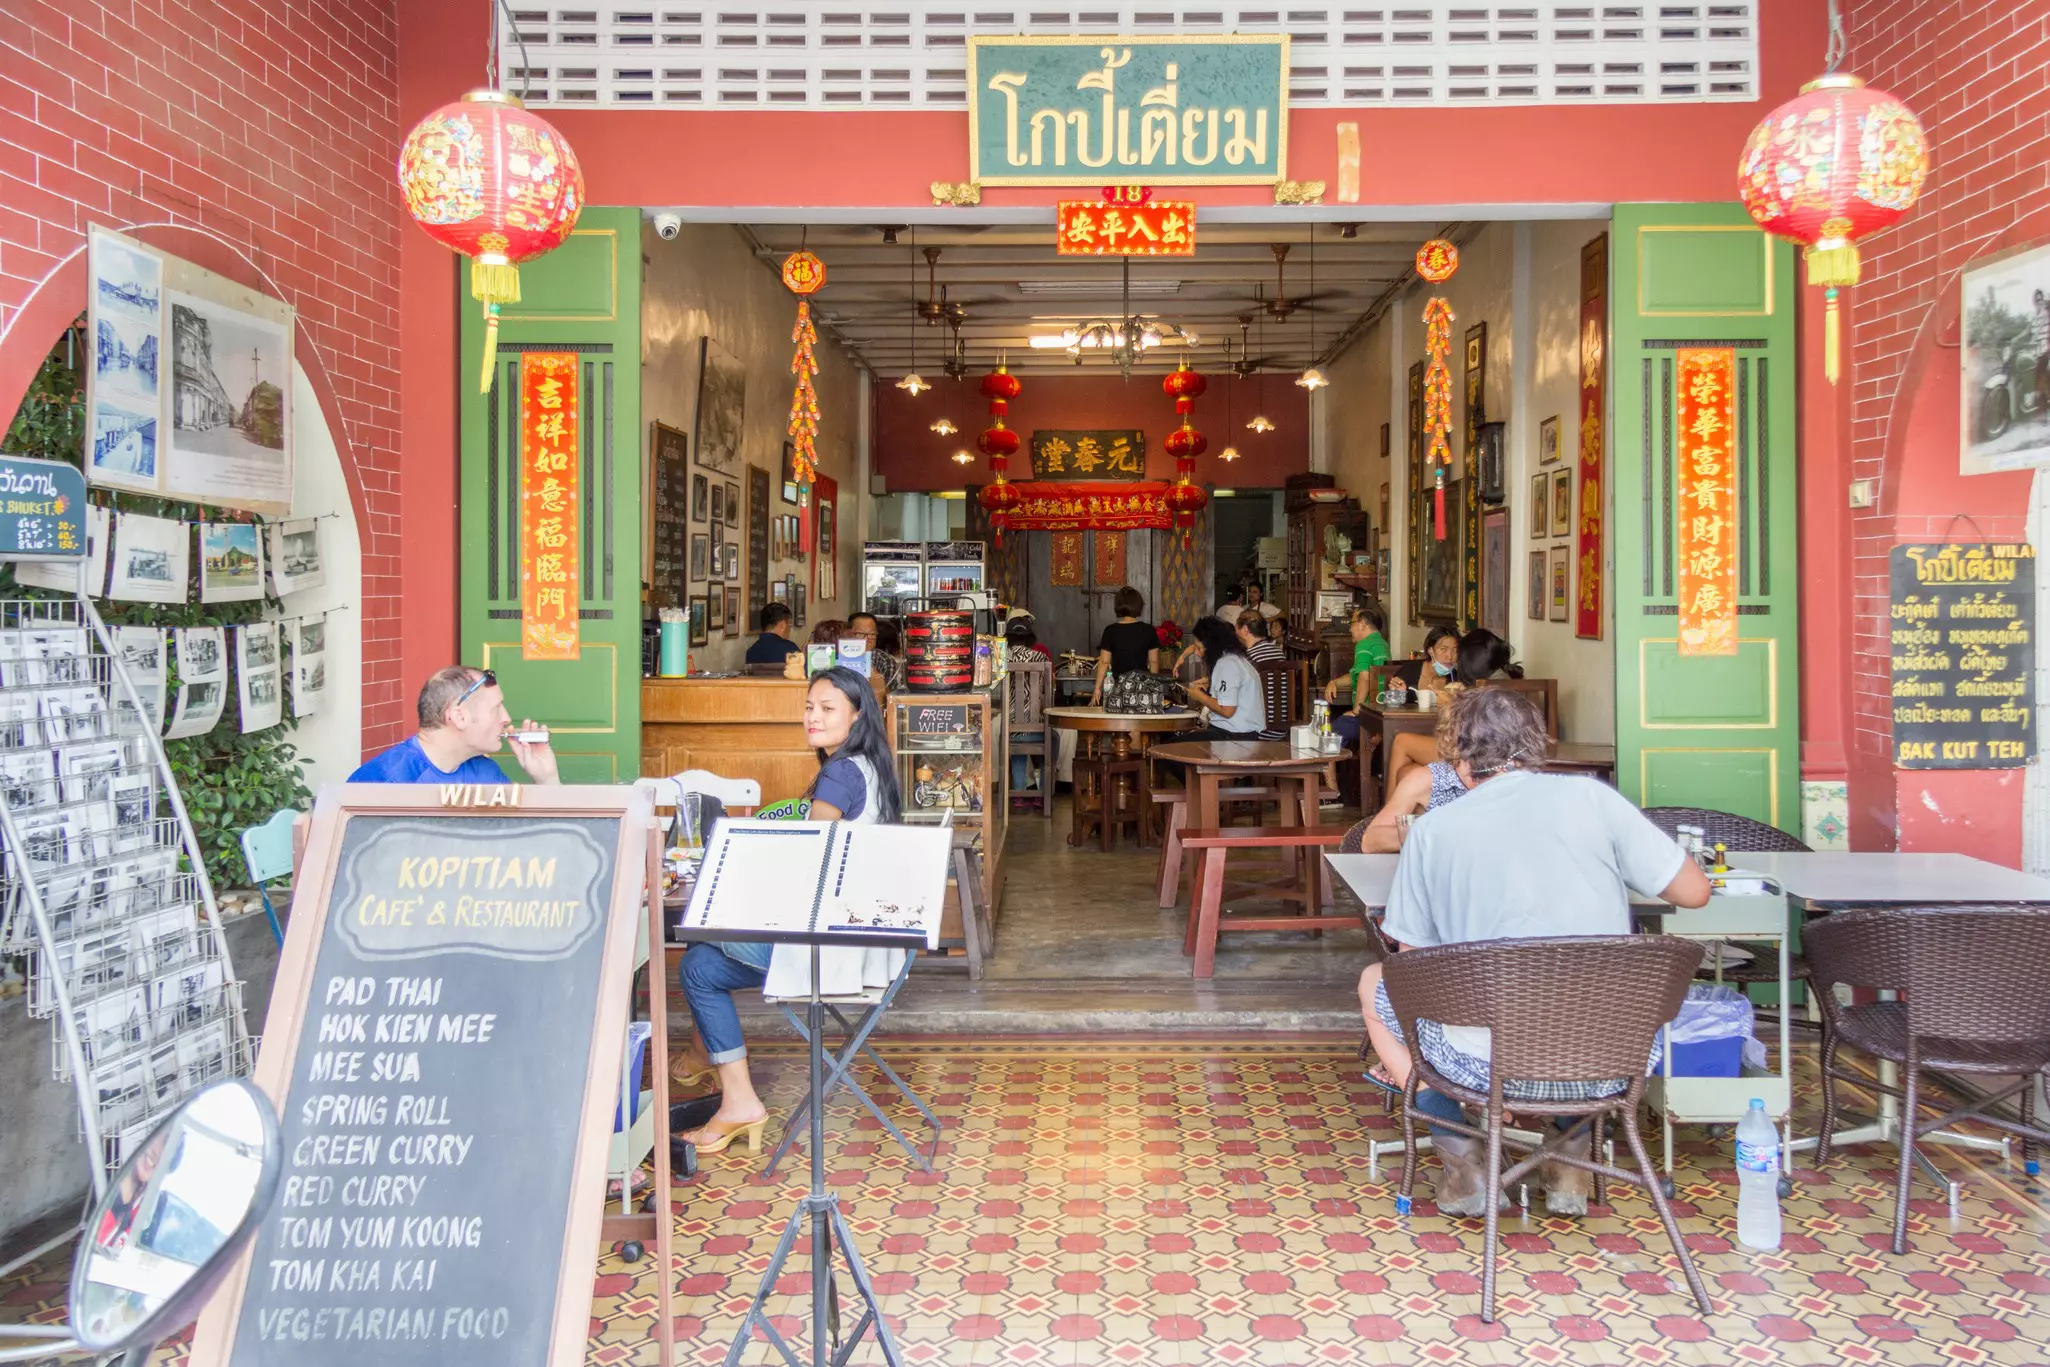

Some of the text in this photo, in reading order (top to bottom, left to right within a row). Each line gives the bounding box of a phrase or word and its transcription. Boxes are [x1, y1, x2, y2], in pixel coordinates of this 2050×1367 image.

[988, 47, 1268, 166] โกปี้เตี่ยม
[1112, 186, 1142, 202] 18
[793, 260, 812, 282] 福
[533, 376, 570, 622] 吉祥如意福臨門
[918, 721, 949, 733] WIFI
[919, 708, 953, 721] FREE
[1899, 741, 2026, 760] BAK KUT TEH
[440, 783, 521, 807] WILAI
[398, 856, 558, 889] KOPITIAM
[427, 901, 446, 925] &
[455, 895, 579, 928] RESTAURANT
[325, 976, 443, 1007] PAD THAI
[318, 1014, 497, 1043] HOK KIEN MEE
[309, 1051, 420, 1083] MEE SUA
[302, 1095, 451, 1126] SPRING ROLL
[292, 1134, 474, 1167] GREEN CURRY
[283, 1175, 427, 1207] RED CURRY
[279, 1216, 482, 1248] TOM YUM KOONG
[269, 1259, 437, 1291] TOM KHA KAI
[259, 1306, 509, 1341] VEGETARIAN FOOD
